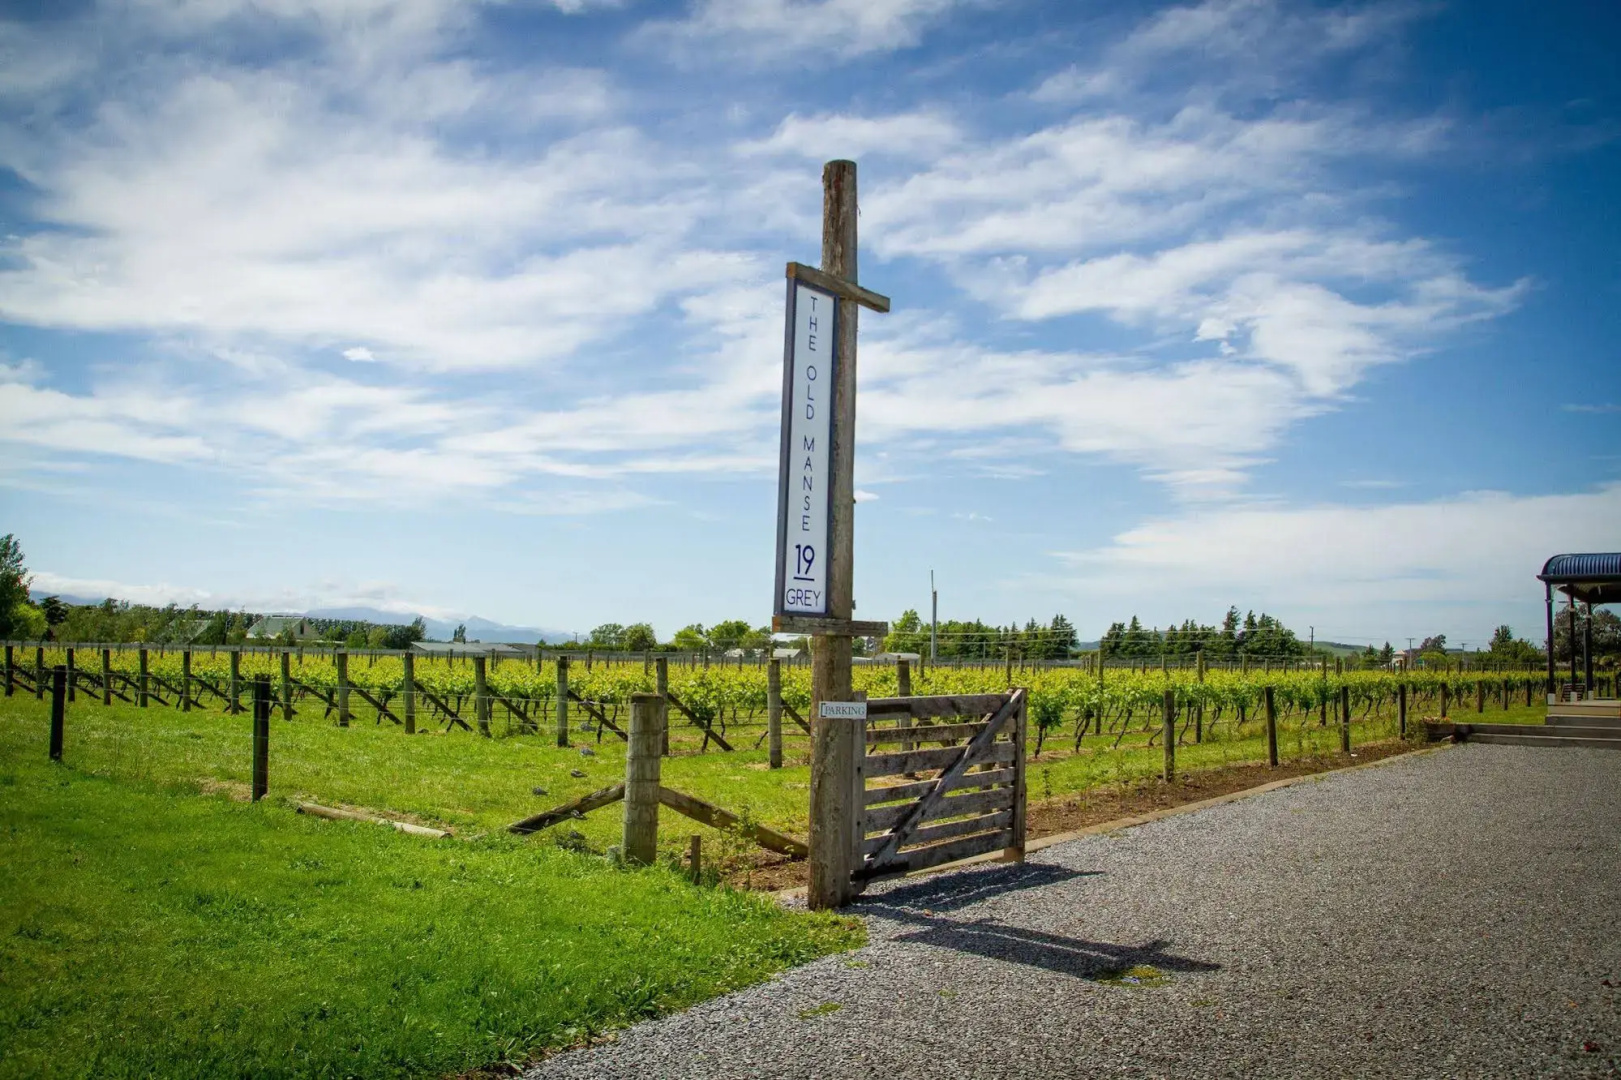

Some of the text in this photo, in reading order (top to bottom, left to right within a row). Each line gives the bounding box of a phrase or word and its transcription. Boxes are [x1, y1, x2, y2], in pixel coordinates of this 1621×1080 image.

[802, 296, 818, 532] THE OLD MANSE
[795, 544, 815, 575] 19
[786, 588, 821, 607] GREY
[824, 705, 865, 716] PARKING
